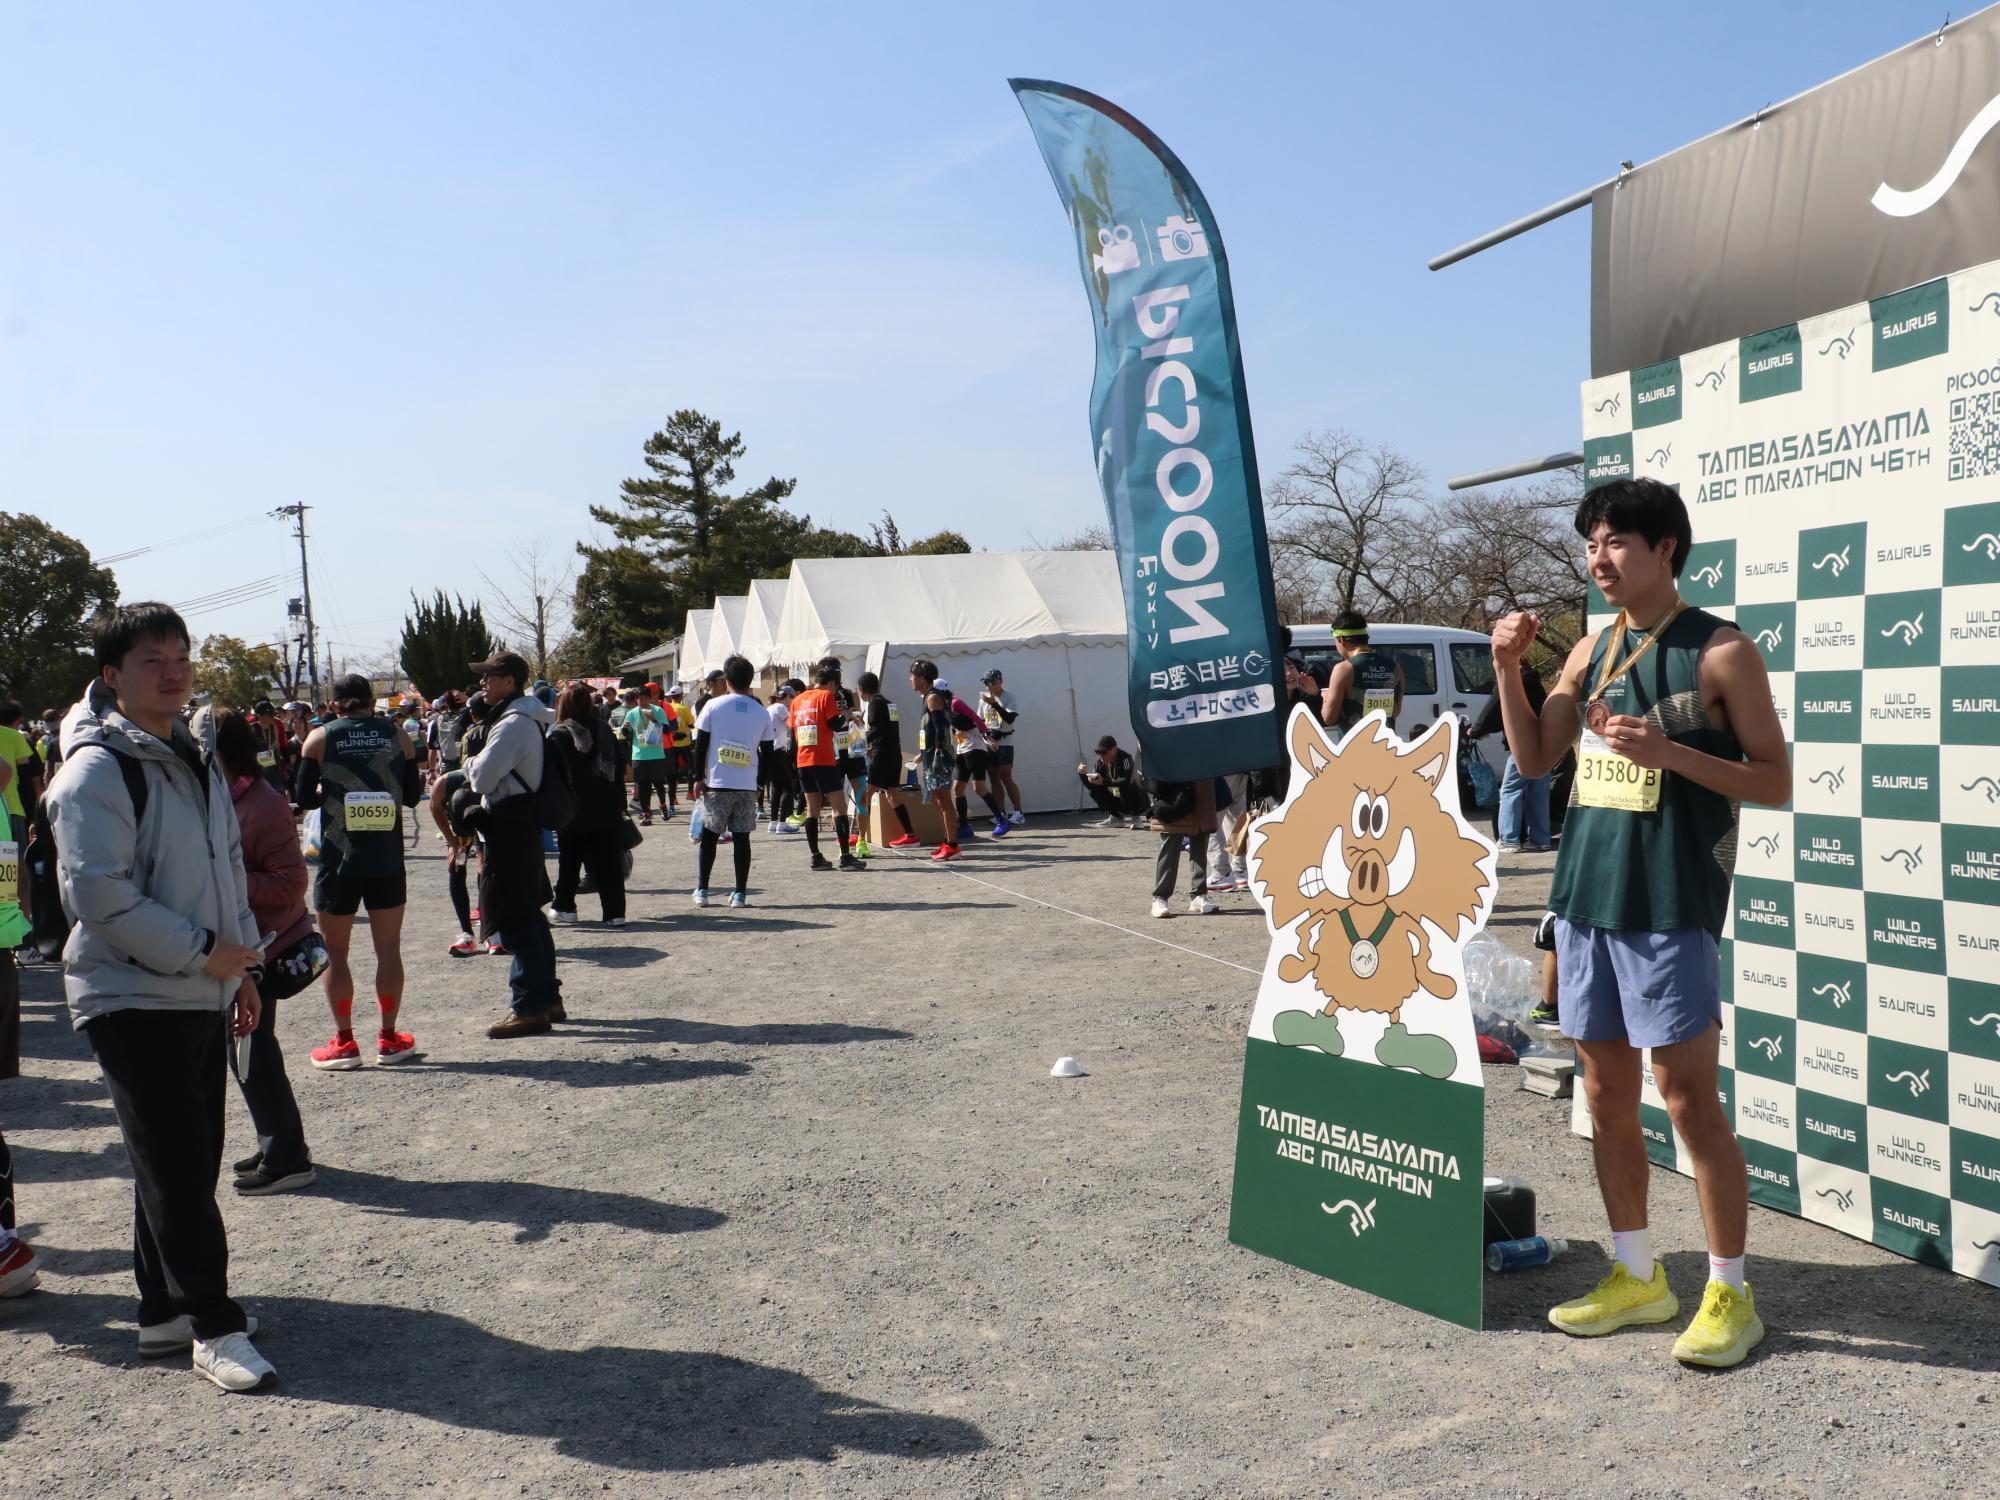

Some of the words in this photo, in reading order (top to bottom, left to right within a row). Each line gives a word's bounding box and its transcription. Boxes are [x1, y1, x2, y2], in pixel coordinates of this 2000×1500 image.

[1882, 311, 1937, 339] SAURUS
[1748, 352, 1793, 375] SAURUS
[1638, 384, 1676, 404] SAURUS
[1697, 407, 1931, 477] TAMBASASAYAMA
[1597, 454, 1621, 466] WILD
[1589, 464, 1630, 479] RUNNERS
[1697, 473, 1737, 504] ABC
[1745, 455, 1862, 497] MARATHON
[1870, 447, 1931, 474] 46TH
[1877, 544, 1932, 562] SAURUS
[1745, 561, 1789, 576] SAURUS
[1814, 621, 1843, 634] WILD
[1950, 626, 2000, 639] RUNNE
[1802, 634, 1856, 648] RUNNERS
[1803, 700, 1851, 713] SAURUS
[1884, 692, 1916, 705] WILD
[1870, 707, 1931, 720] RUNNERS
[336, 737, 393, 749] RUNNERS
[348, 730, 379, 738] WILD
[1583, 758, 1640, 784] 31580
[1645, 770, 1656, 786] B
[1872, 775, 1928, 790] SAURUS
[349, 806, 389, 818] 30659
[1812, 837, 1841, 851] WILD
[1800, 849, 1855, 866] RUNNERS
[1751, 898, 1777, 913] WILD
[1739, 910, 1789, 927] RUNNERS
[1804, 912, 1855, 931] SAURUS
[1887, 917, 1920, 933] WILD
[1873, 930, 1937, 950] RUNNERS
[1743, 969, 1788, 989] SAURUS
[1878, 995, 1936, 1018] SAURUS
[1815, 1046, 1845, 1063] WILD
[1803, 1056, 1859, 1080] RUNNERS
[1753, 1097, 1778, 1113] WILD
[1958, 1093, 2000, 1114] RUNN
[1742, 1105, 1789, 1129] RUNNERS
[1805, 1117, 1857, 1143] SAURUS
[1257, 1104, 1460, 1180] TAMBASASAYAMA
[1891, 1135, 1926, 1154] WILD
[1877, 1144, 1941, 1172] RUNNERS
[1276, 1138, 1314, 1165] ABC
[1321, 1150, 1432, 1199] MARATHON
[1746, 1164, 1790, 1187] SAURUS
[1882, 1207, 1941, 1236] SAURUS
